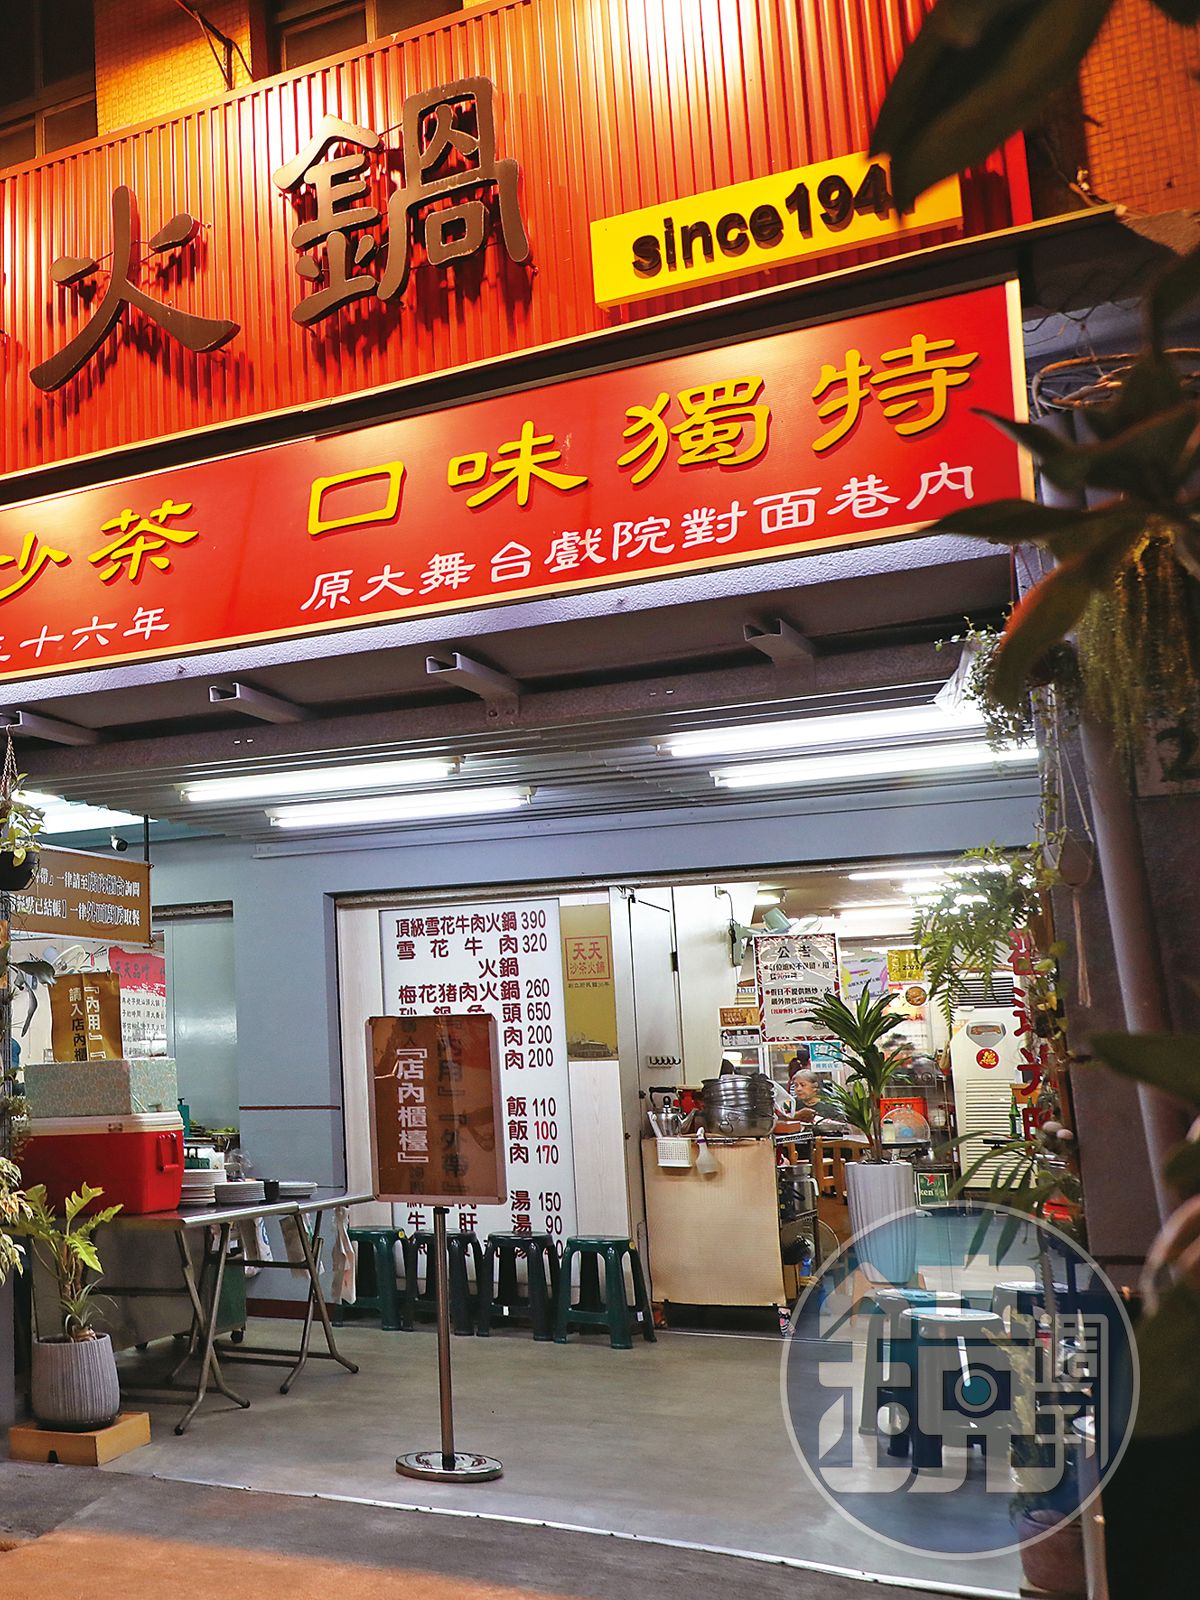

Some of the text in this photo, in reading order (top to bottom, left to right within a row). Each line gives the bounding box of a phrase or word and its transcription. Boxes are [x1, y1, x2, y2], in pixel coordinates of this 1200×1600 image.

[632, 163, 915, 279] since194
[307, 333, 980, 536] 口味獨特
[396, 909, 547, 938] 頂級雪花牛肉火鍋 390
[522, 933, 548, 953] 320
[573, 941, 603, 960] 天天
[478, 957, 519, 978] 火鍋
[569, 961, 605, 975] 沙茶火鍋
[526, 978, 550, 999] 260
[527, 1002, 551, 1021] 650
[504, 1025, 553, 1047] 肉 200
[505, 1048, 554, 1070] 肉 200
[507, 1095, 557, 1117] 飯 110
[508, 1119, 558, 1141] 飯 100
[510, 1143, 559, 1164] 肉 170
[510, 1190, 562, 1212] 湯 150
[545, 1215, 563, 1235] 90
